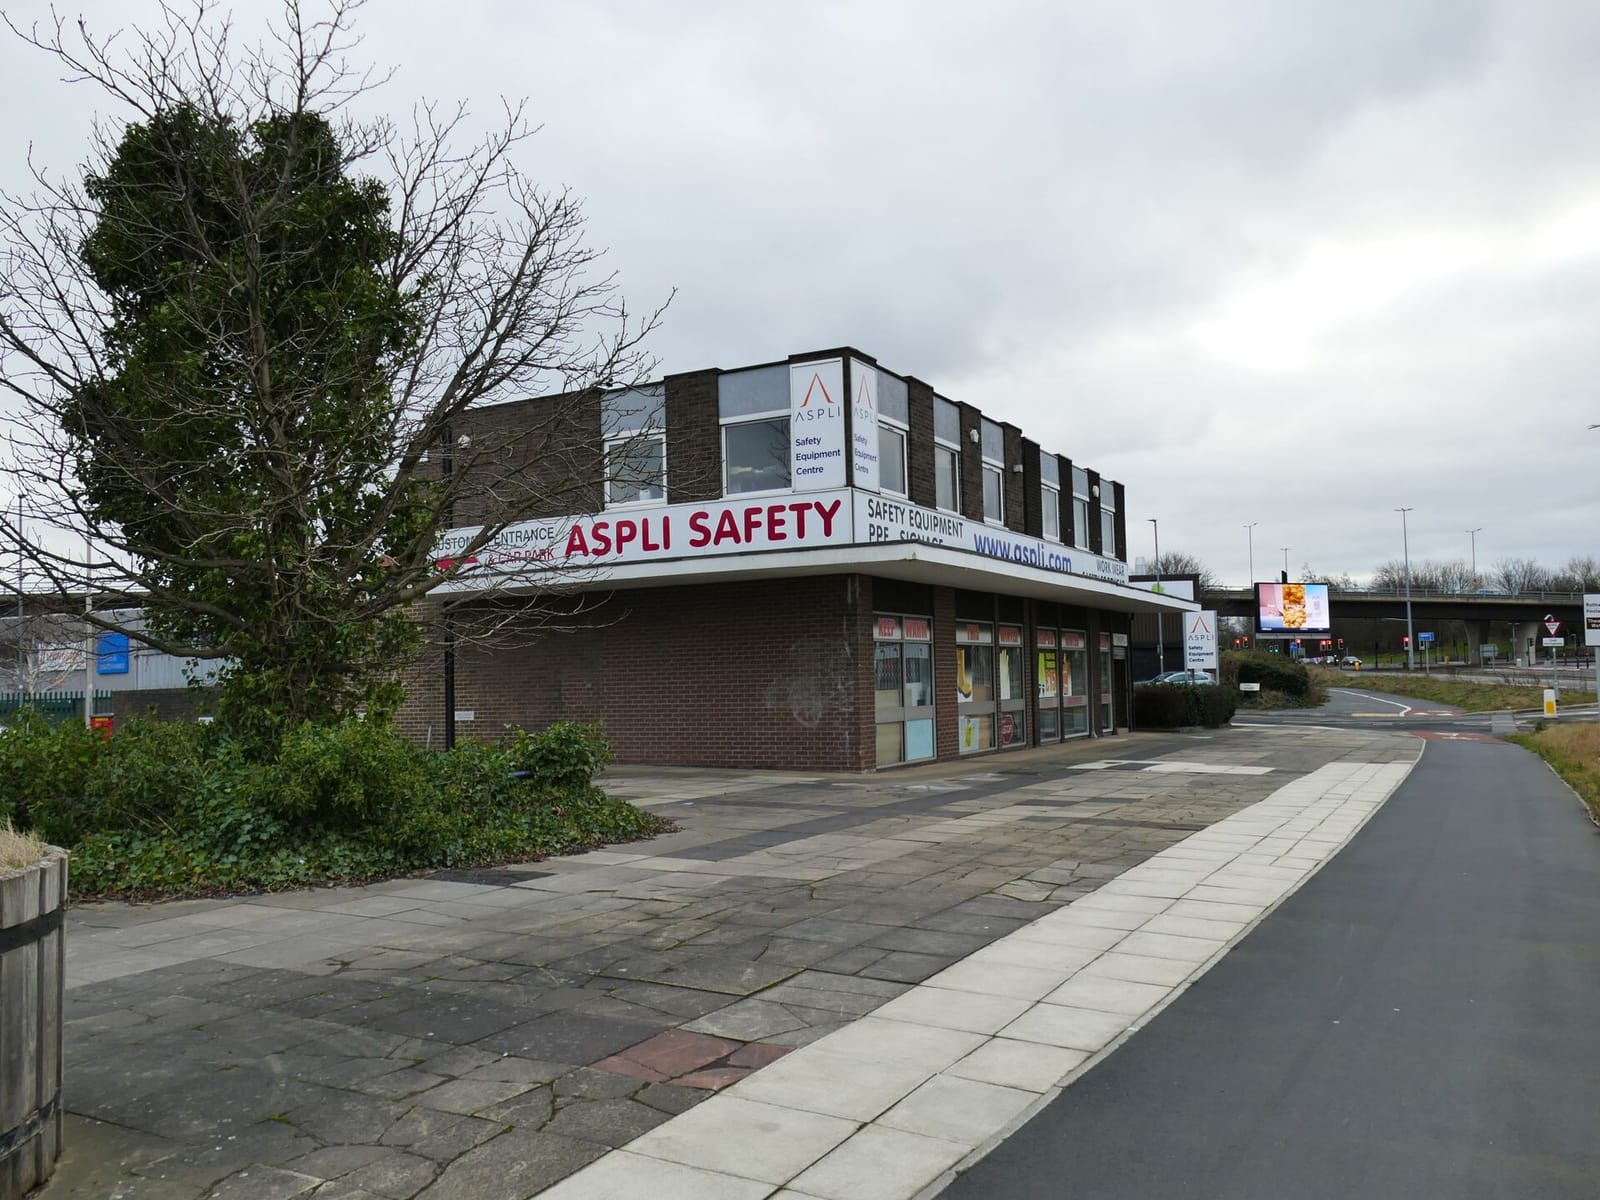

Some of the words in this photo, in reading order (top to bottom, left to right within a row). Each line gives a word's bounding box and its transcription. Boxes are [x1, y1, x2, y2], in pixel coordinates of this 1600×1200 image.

[795, 407, 840, 423] ASPLI
[795, 437, 822, 447] Safety
[795, 449, 841, 462] Equipment
[796, 466, 824, 475] Centre
[868, 498, 906, 525] SAFETY
[908, 509, 964, 539] EQUIPMENT
[494, 526, 555, 546] ENTRANCE
[564, 515, 671, 558] ASPLI
[688, 499, 841, 548] SAFETY
[973, 533, 1072, 573] www.aspli.com
